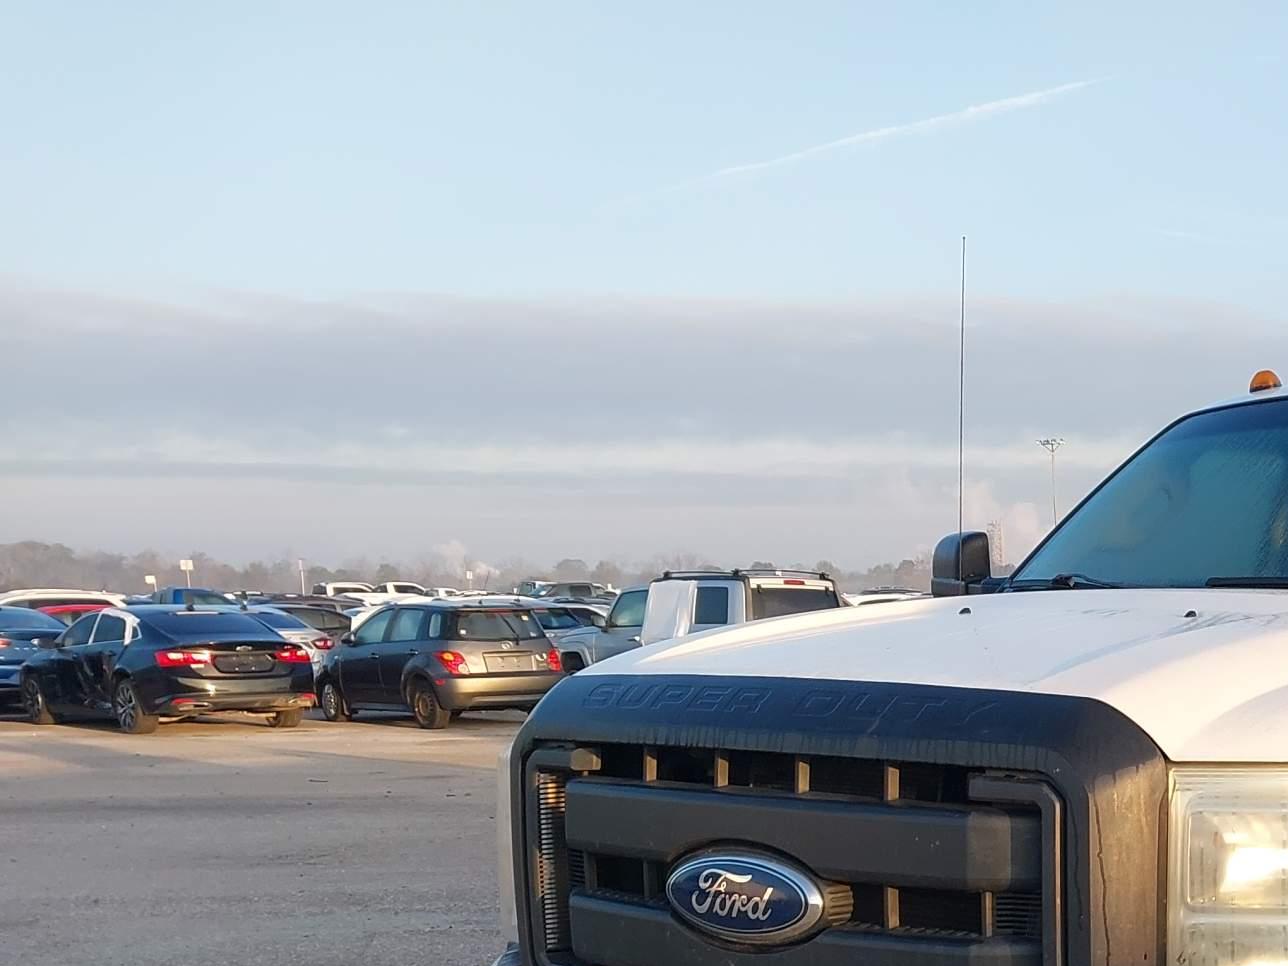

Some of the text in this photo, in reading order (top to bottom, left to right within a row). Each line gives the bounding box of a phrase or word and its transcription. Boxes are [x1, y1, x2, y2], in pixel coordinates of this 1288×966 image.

[583, 682, 1000, 728] SUPER DUTY
[691, 868, 774, 921] Ford
